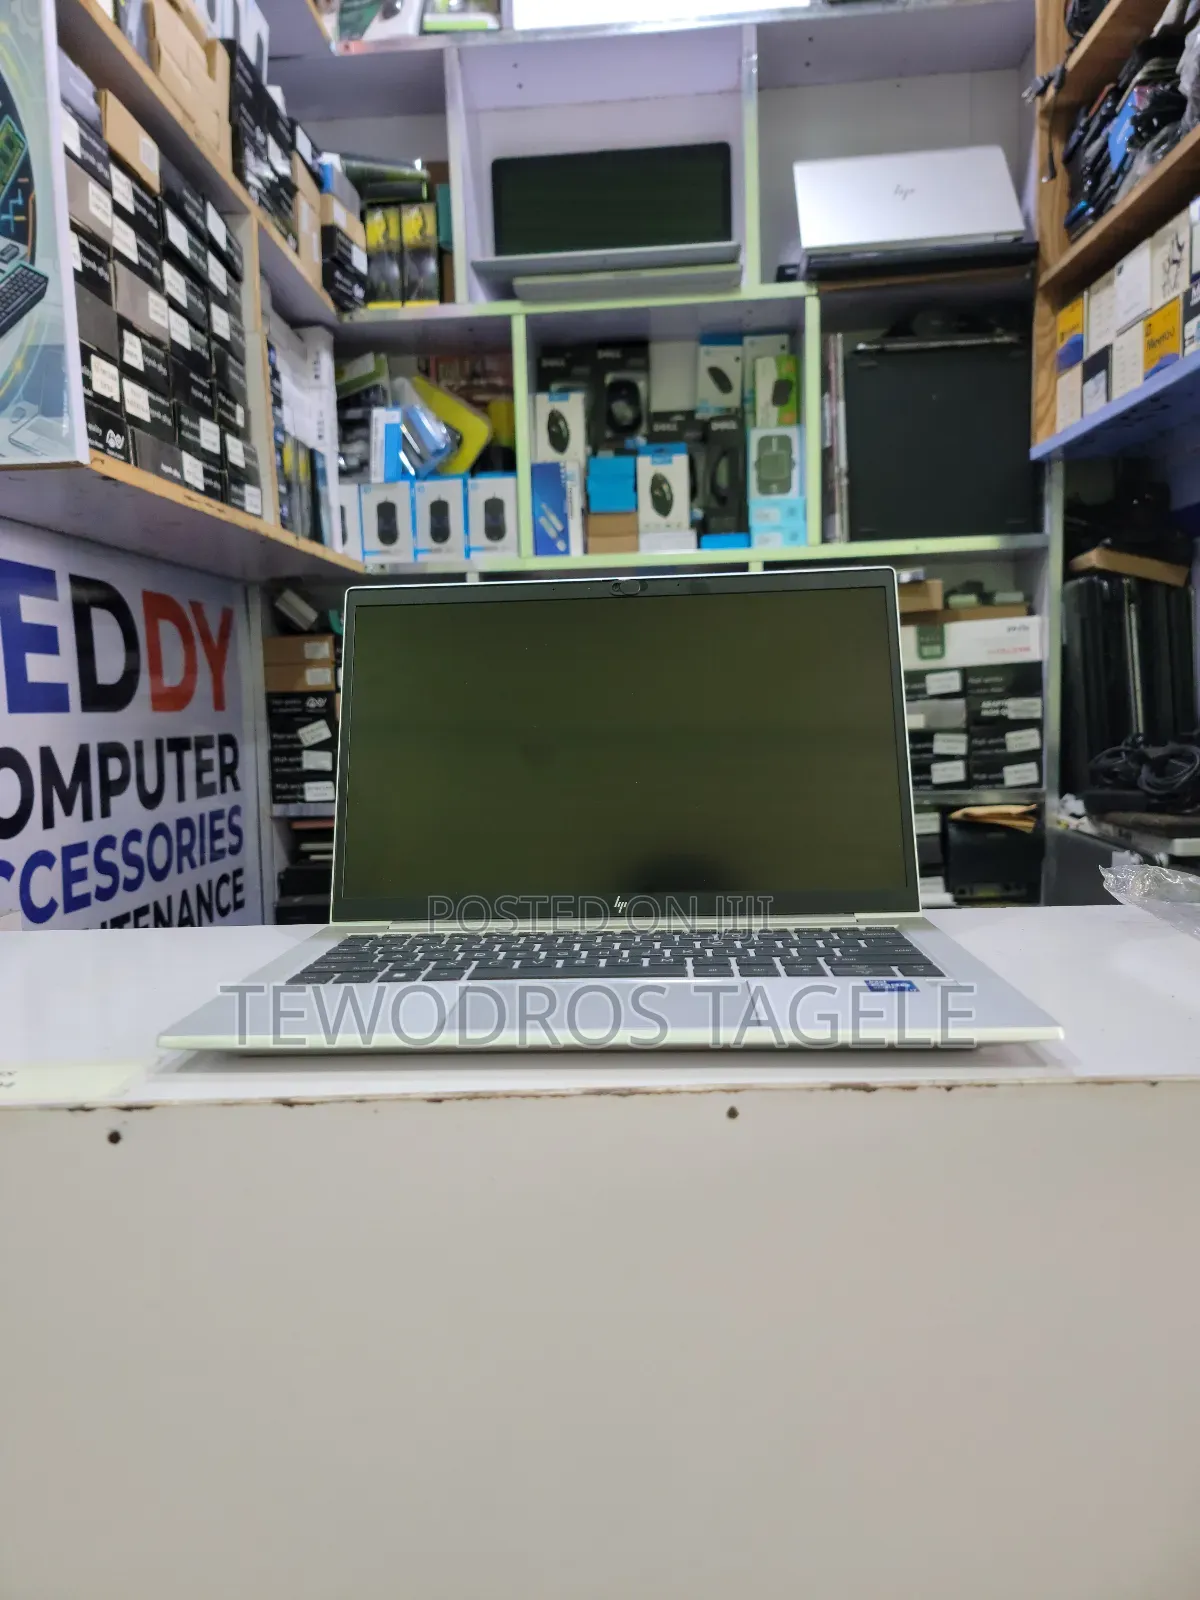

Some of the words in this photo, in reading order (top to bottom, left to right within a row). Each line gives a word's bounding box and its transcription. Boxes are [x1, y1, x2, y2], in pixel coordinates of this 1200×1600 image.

[0, 558, 235, 713] EDDY
[0, 733, 242, 840] OMPUTER
[100, 867, 246, 929] ENANCE
[613, 895, 628, 914] hp
